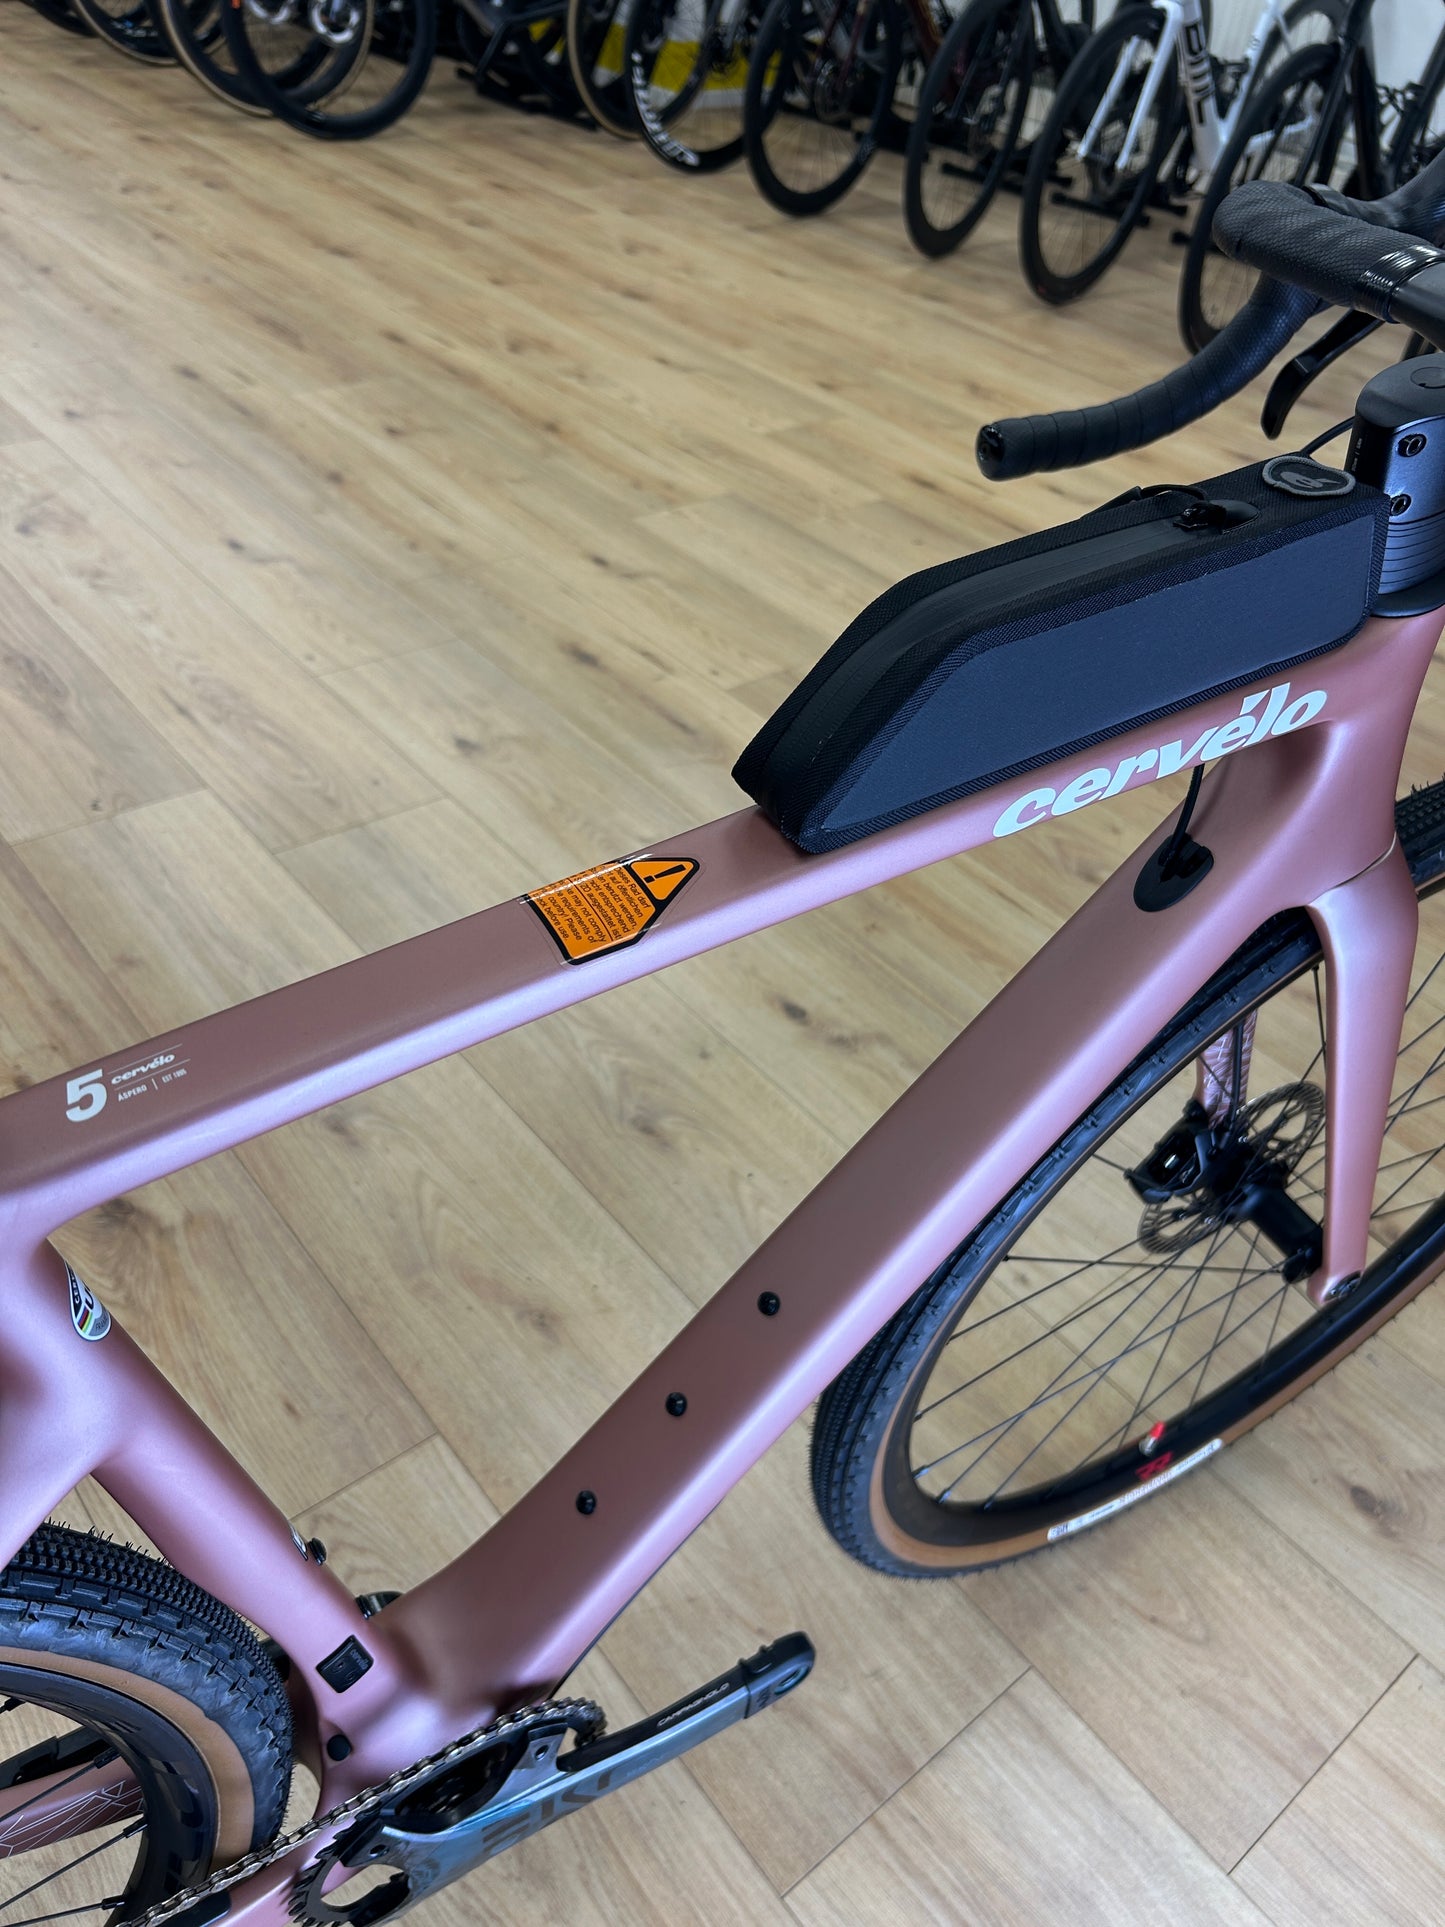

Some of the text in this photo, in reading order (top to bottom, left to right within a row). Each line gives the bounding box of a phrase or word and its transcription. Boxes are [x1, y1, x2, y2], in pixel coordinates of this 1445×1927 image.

[992, 682, 1327, 839] cervélo
[586, 892, 615, 929] ausgestattet
[598, 890, 631, 933] entsprechend
[603, 881, 622, 903] benutzt
[618, 903, 637, 929] werden,
[609, 874, 643, 917] auf öffentlichen
[628, 883, 640, 896] Rad
[637, 896, 650, 908] darf
[543, 906, 561, 927] before
[557, 926, 570, 940] use.
[560, 896, 590, 935] requirements
[587, 934, 596, 943] of
[565, 917, 582, 940] Please
[571, 893, 582, 906] may
[580, 906, 591, 917] not
[587, 916, 607, 943] comply
[111, 1054, 175, 1084] cervélo
[65, 1068, 107, 1123] 5
